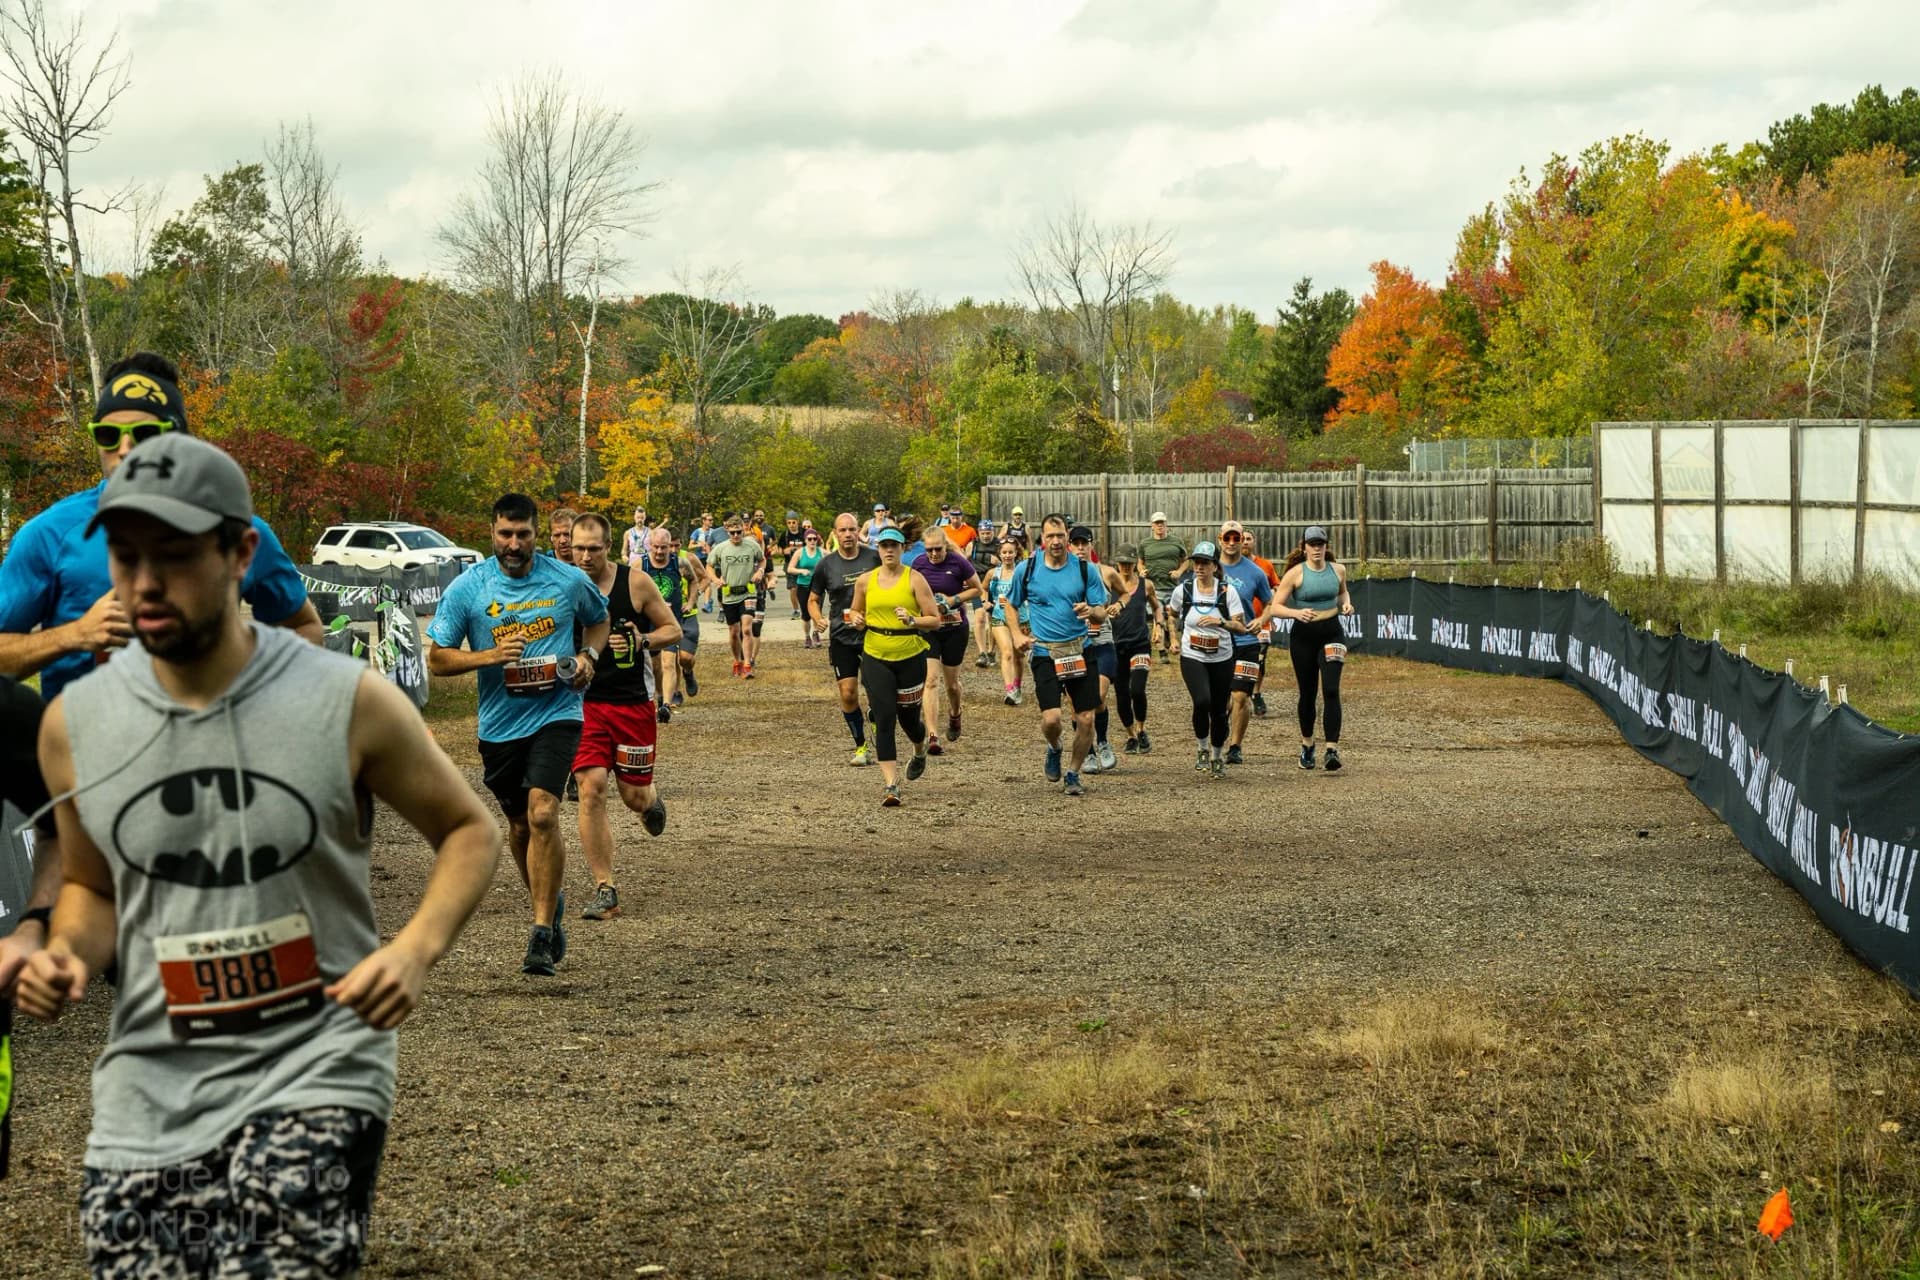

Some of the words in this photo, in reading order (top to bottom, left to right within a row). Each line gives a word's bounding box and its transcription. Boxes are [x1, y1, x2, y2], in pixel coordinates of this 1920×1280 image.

[725, 555, 750, 563] FXR
[519, 665, 545, 682] 965
[195, 950, 280, 1003] 988
